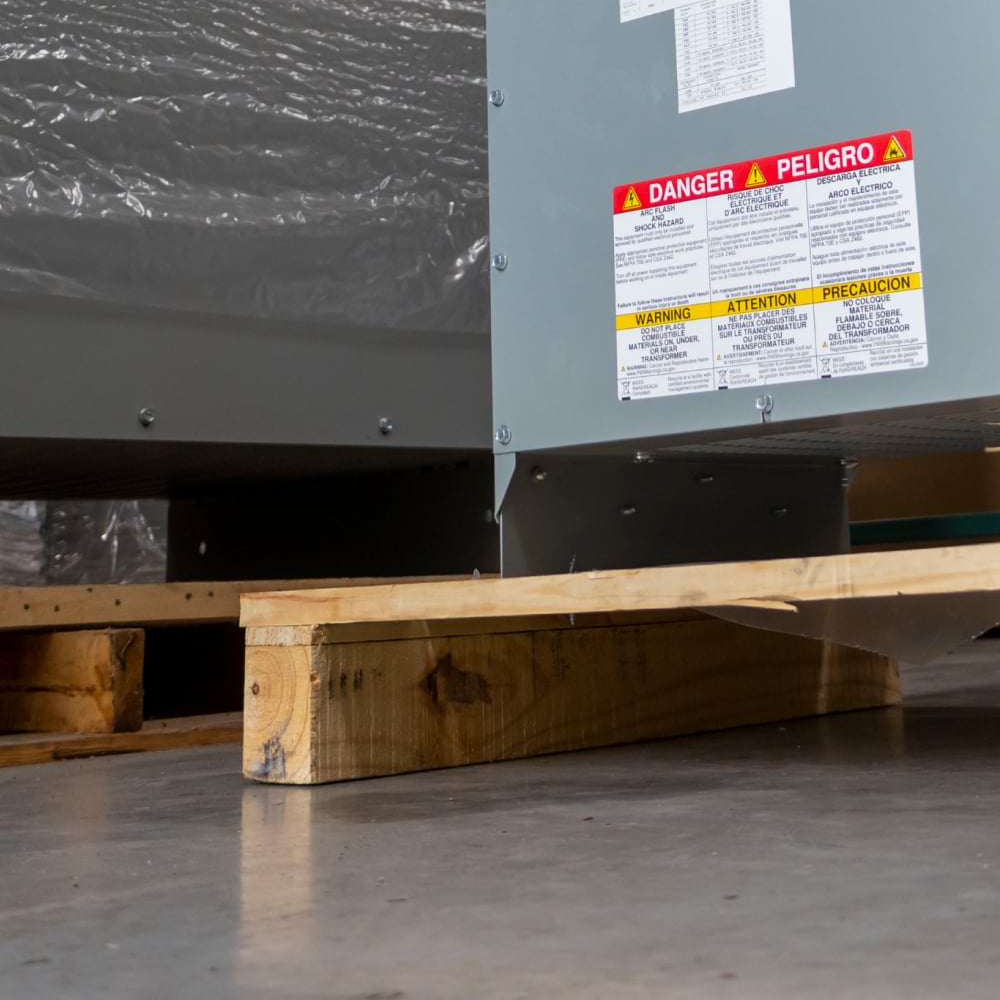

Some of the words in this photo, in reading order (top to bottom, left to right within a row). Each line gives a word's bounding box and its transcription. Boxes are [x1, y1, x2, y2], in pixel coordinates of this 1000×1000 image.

[648, 169, 733, 203] DANGER
[776, 142, 874, 180] PELIGRO
[816, 171, 857, 185] DESCARGA
[727, 190, 751, 201] RISQUE
[753, 188, 762, 196] DE
[764, 184, 784, 194] CHOC
[828, 189, 849, 198] ARCO
[640, 208, 653, 216] ARC
[654, 204, 675, 214] FLASH
[634, 223, 656, 232] SHOCK
[657, 218, 684, 228] HAZARD
[822, 275, 910, 300] PRECAUCION
[727, 292, 797, 313] ATTENTION
[842, 299, 853, 307] NO
[855, 294, 890, 305] COLOQUE
[849, 303, 885, 314] MATERIAL
[635, 307, 691, 326] WARNING
[739, 313, 752, 321] PAS
[753, 310, 779, 319] PLACER
[756, 313, 808, 326] COMBUSTIBLES
[835, 312, 875, 324] FLAMABLE
[665, 323, 685, 331] PLACE
[744, 321, 806, 335] TRANSFORMATEUR
[836, 322, 865, 331] DEBAJO
[874, 317, 900, 327] CERCA
[641, 330, 685, 341] COMBUSTIBLE
[742, 335, 752, 343] OU
[773, 331, 782, 339] DU
[828, 332, 842, 340] DEL
[844, 324, 909, 338] TRANSFORMADOR
[628, 340, 662, 350] MATERIALS
[660, 345, 677, 353] NEAR
[732, 338, 794, 351] TRANSFORMATEUR
[641, 351, 687, 363] TRANSFORMER
